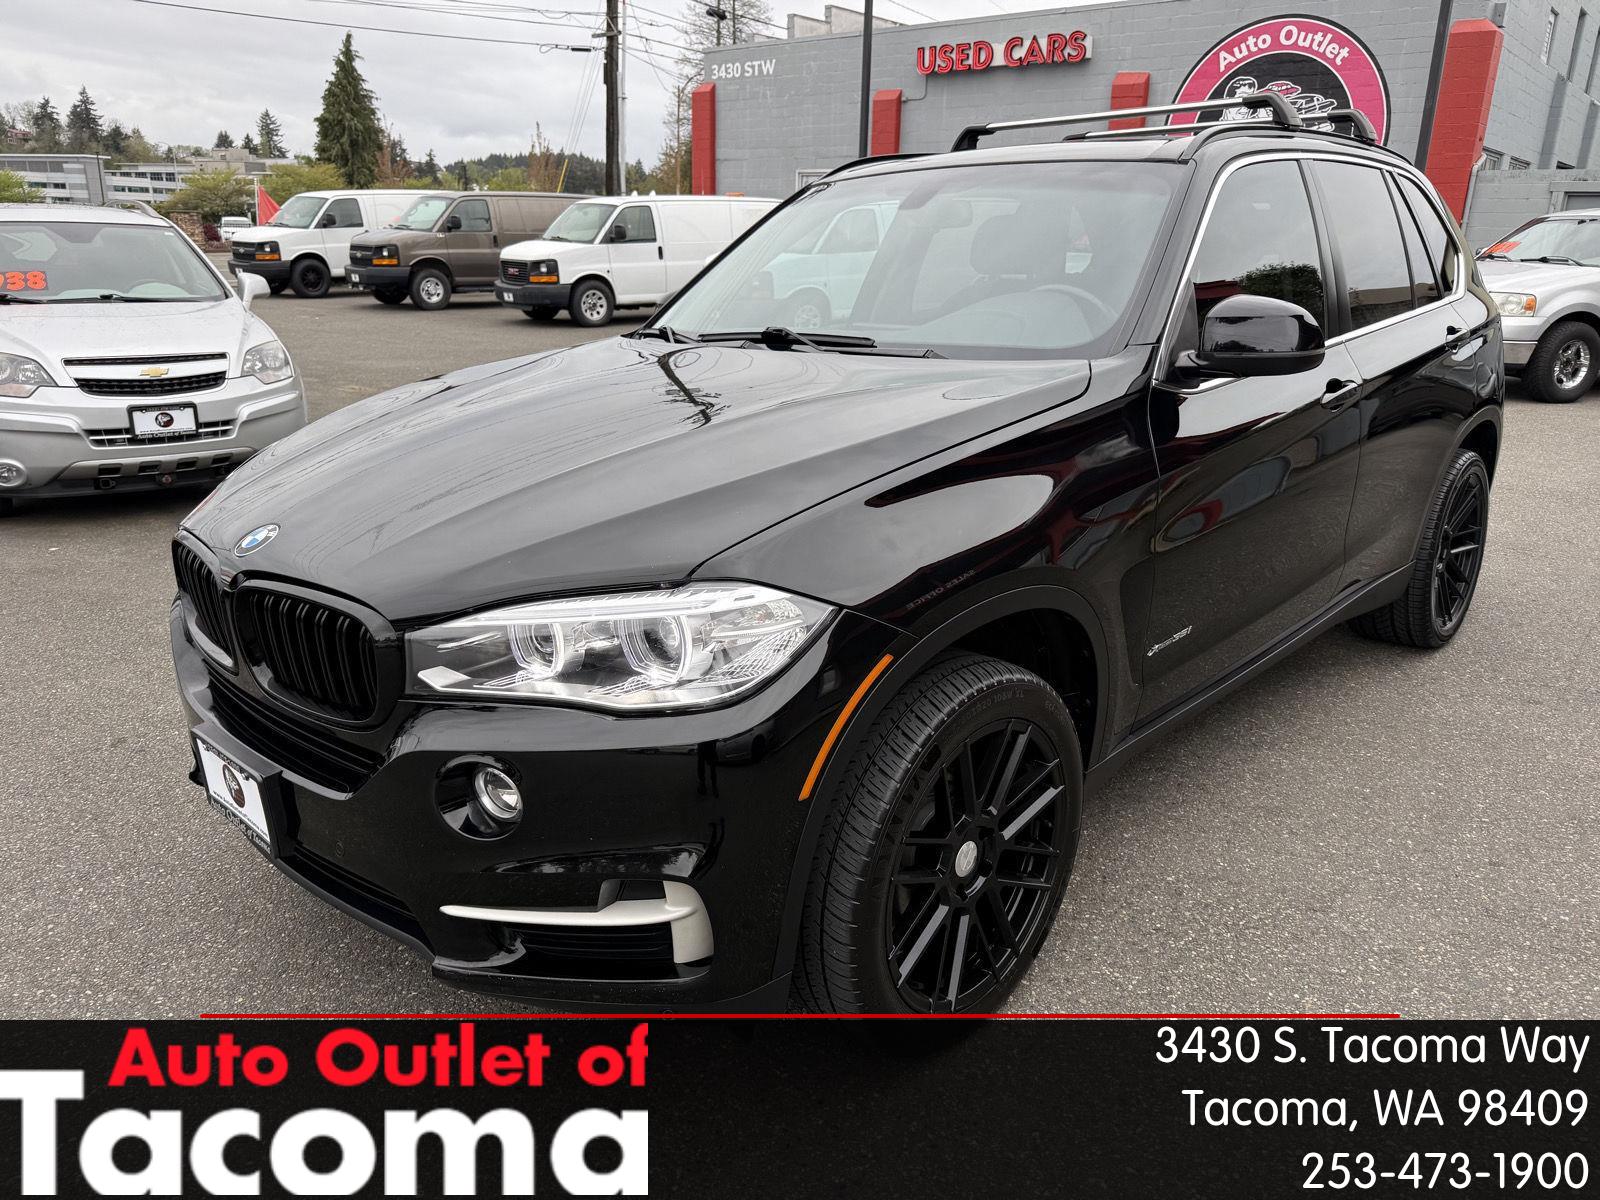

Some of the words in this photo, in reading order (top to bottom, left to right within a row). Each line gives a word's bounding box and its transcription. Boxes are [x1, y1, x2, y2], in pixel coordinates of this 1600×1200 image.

[917, 41, 993, 76] USED
[1003, 31, 1087, 69] CARS
[1218, 33, 1272, 72] Auto
[1279, 25, 1350, 66] Outlet
[711, 61, 742, 80] 3430
[744, 58, 777, 77] STW
[0, 271, 47, 291] 38
